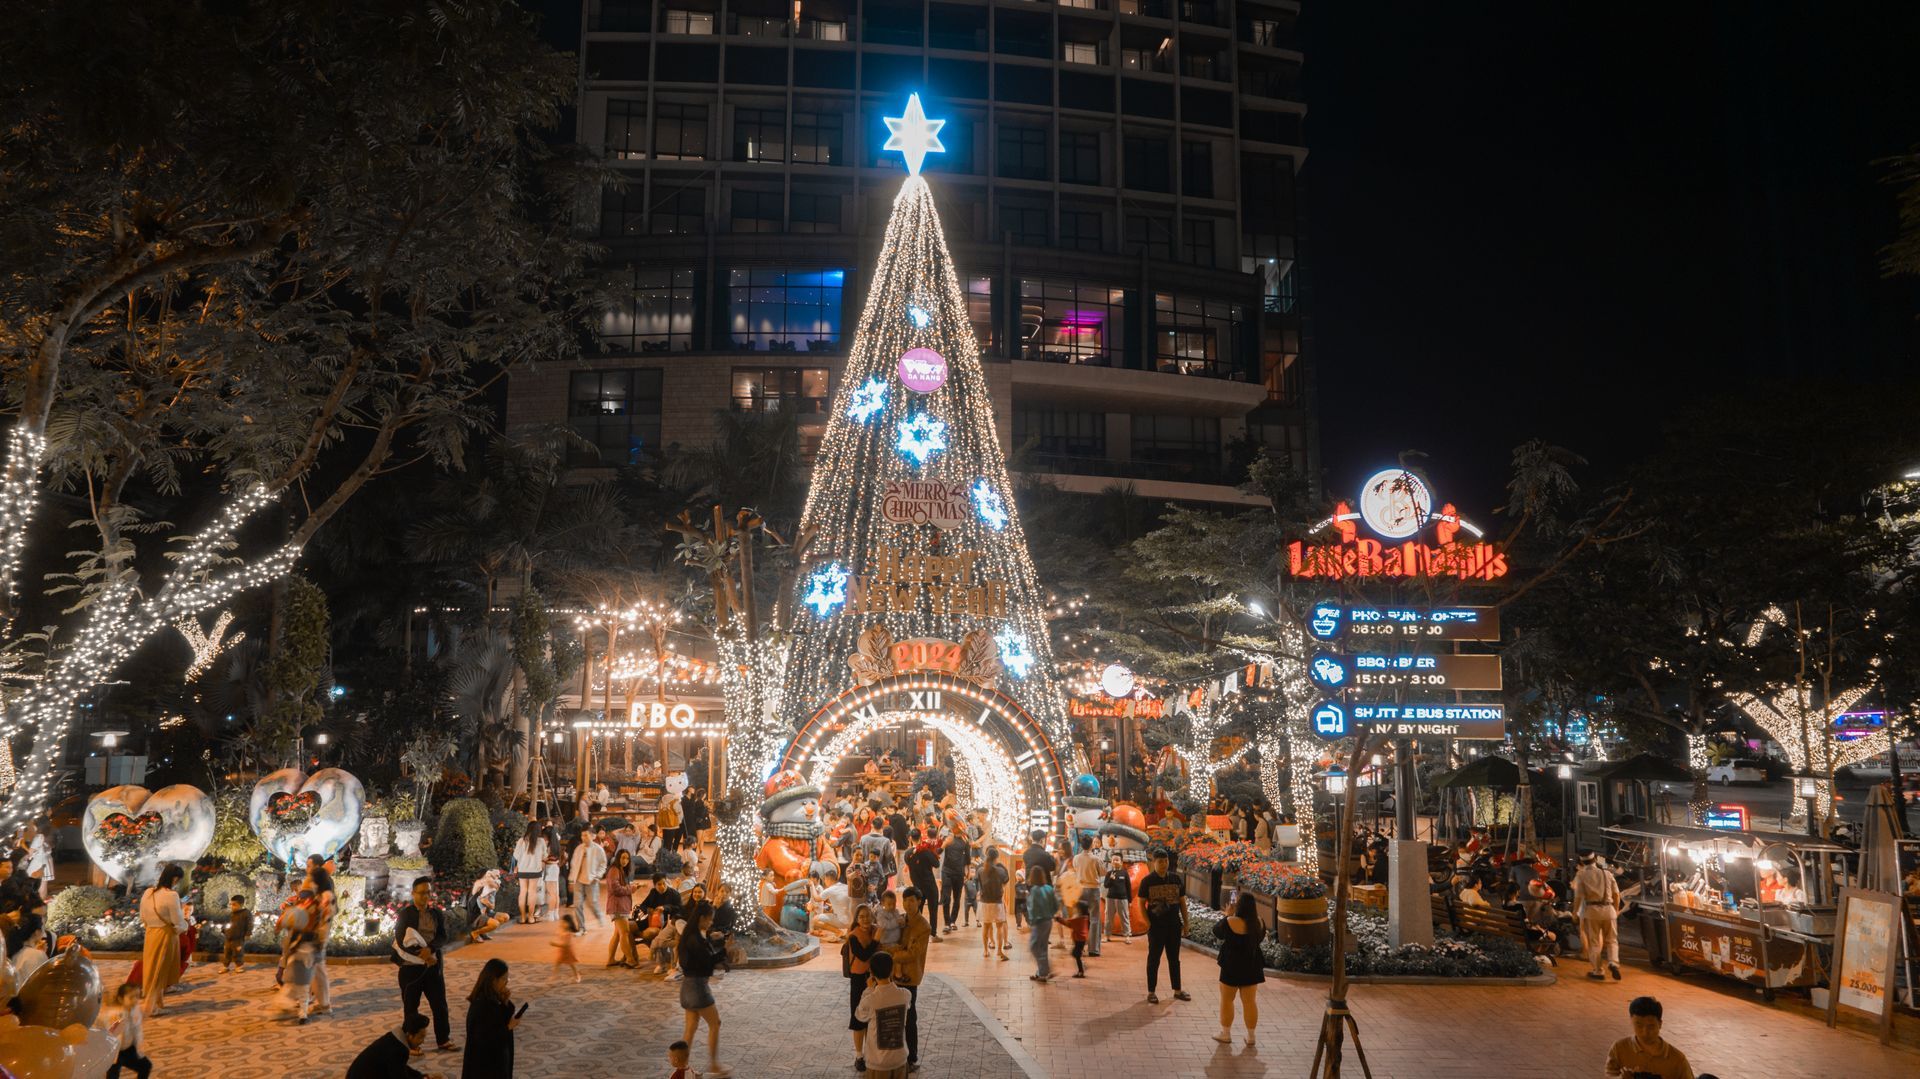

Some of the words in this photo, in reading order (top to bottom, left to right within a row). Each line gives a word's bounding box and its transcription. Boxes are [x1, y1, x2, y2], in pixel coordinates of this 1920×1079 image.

[901, 481, 953, 502] MERRY
[883, 496, 967, 524] CHRISTMAS
[878, 543, 977, 584] HAPPY
[844, 576, 920, 615] NEW
[896, 642, 962, 669] 2024
[1357, 657, 1386, 668] BBQ
[908, 690, 941, 709] XII
[630, 702, 696, 729] BBQ
[1416, 708, 1444, 719] BUS
[1445, 709, 1502, 719] STATION
[1398, 724, 1416, 734] BY
[1418, 724, 1460, 735] NIGHT
[1682, 940, 1699, 952] 20K
[1735, 952, 1753, 965] 25K
[1849, 978, 1878, 994] 25.000
